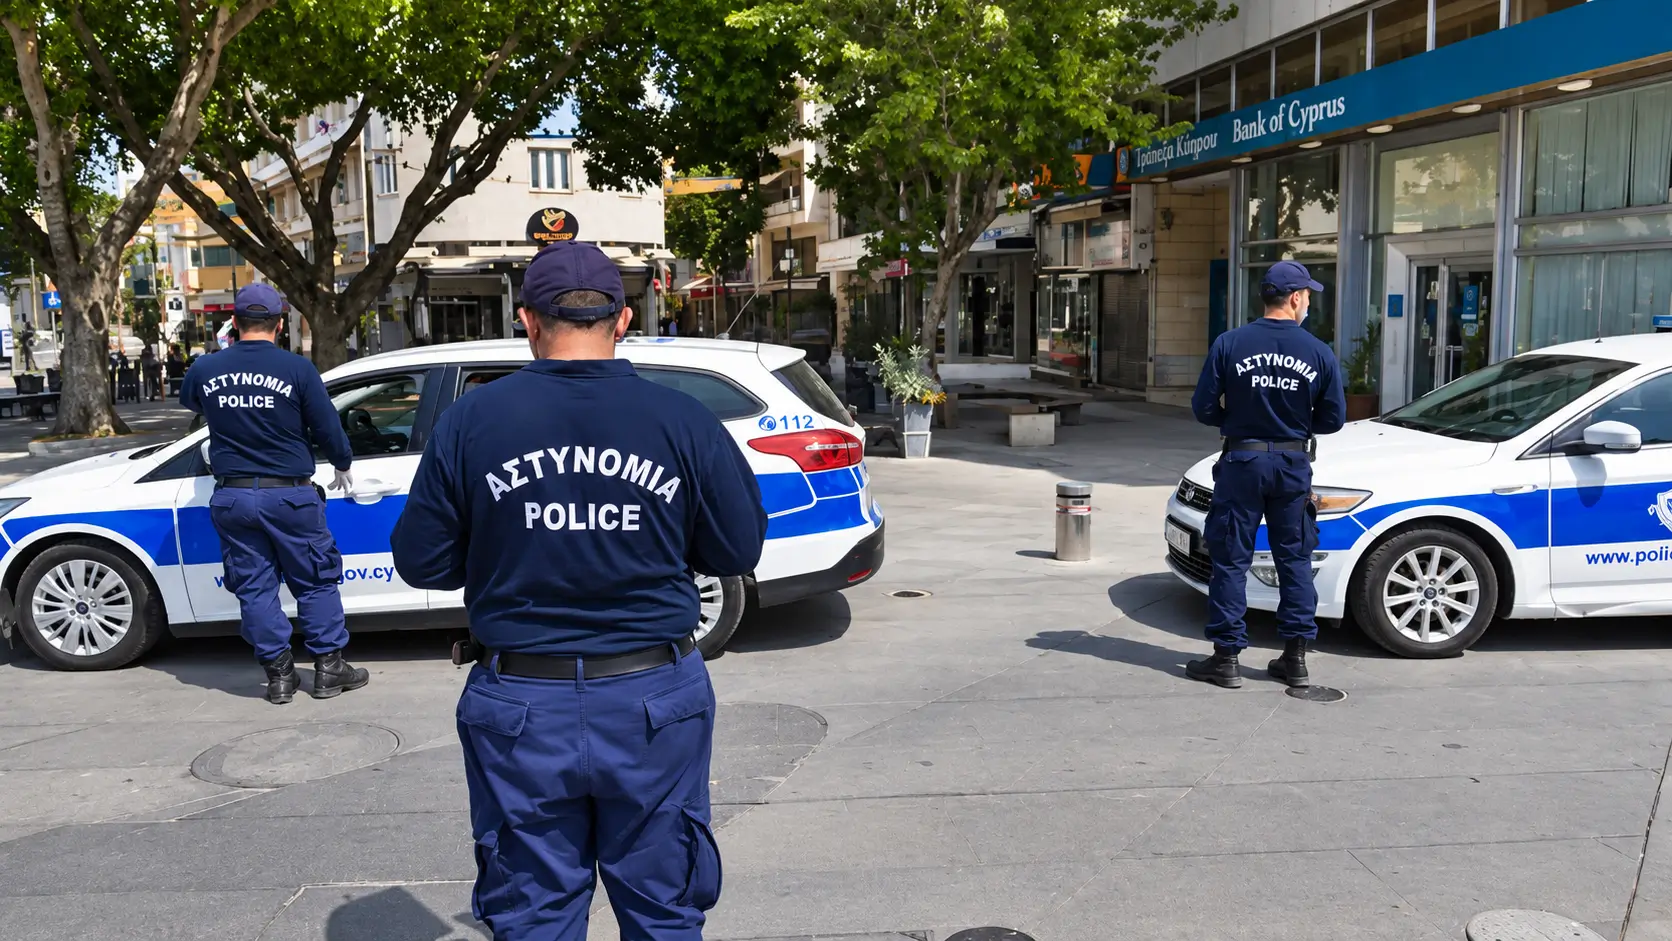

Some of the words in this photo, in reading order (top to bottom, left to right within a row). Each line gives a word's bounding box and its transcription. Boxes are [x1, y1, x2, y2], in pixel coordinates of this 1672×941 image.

[1232, 110, 1267, 143] Bank
[1269, 103, 1286, 133] of
[1288, 96, 1345, 134] Cyprus
[1235, 353, 1318, 383] ΑΣΤΥΝΟΜΙΑ
[202, 372, 293, 398] ΑΣΤΥΝΟΜΙΑ
[1251, 375, 1299, 391] POLICE
[218, 395, 274, 408] POLICE
[779, 415, 814, 429] 112
[485, 445, 681, 504] ΑΣΤΥΝΟΜΙΑ
[524, 501, 641, 531] POLICE
